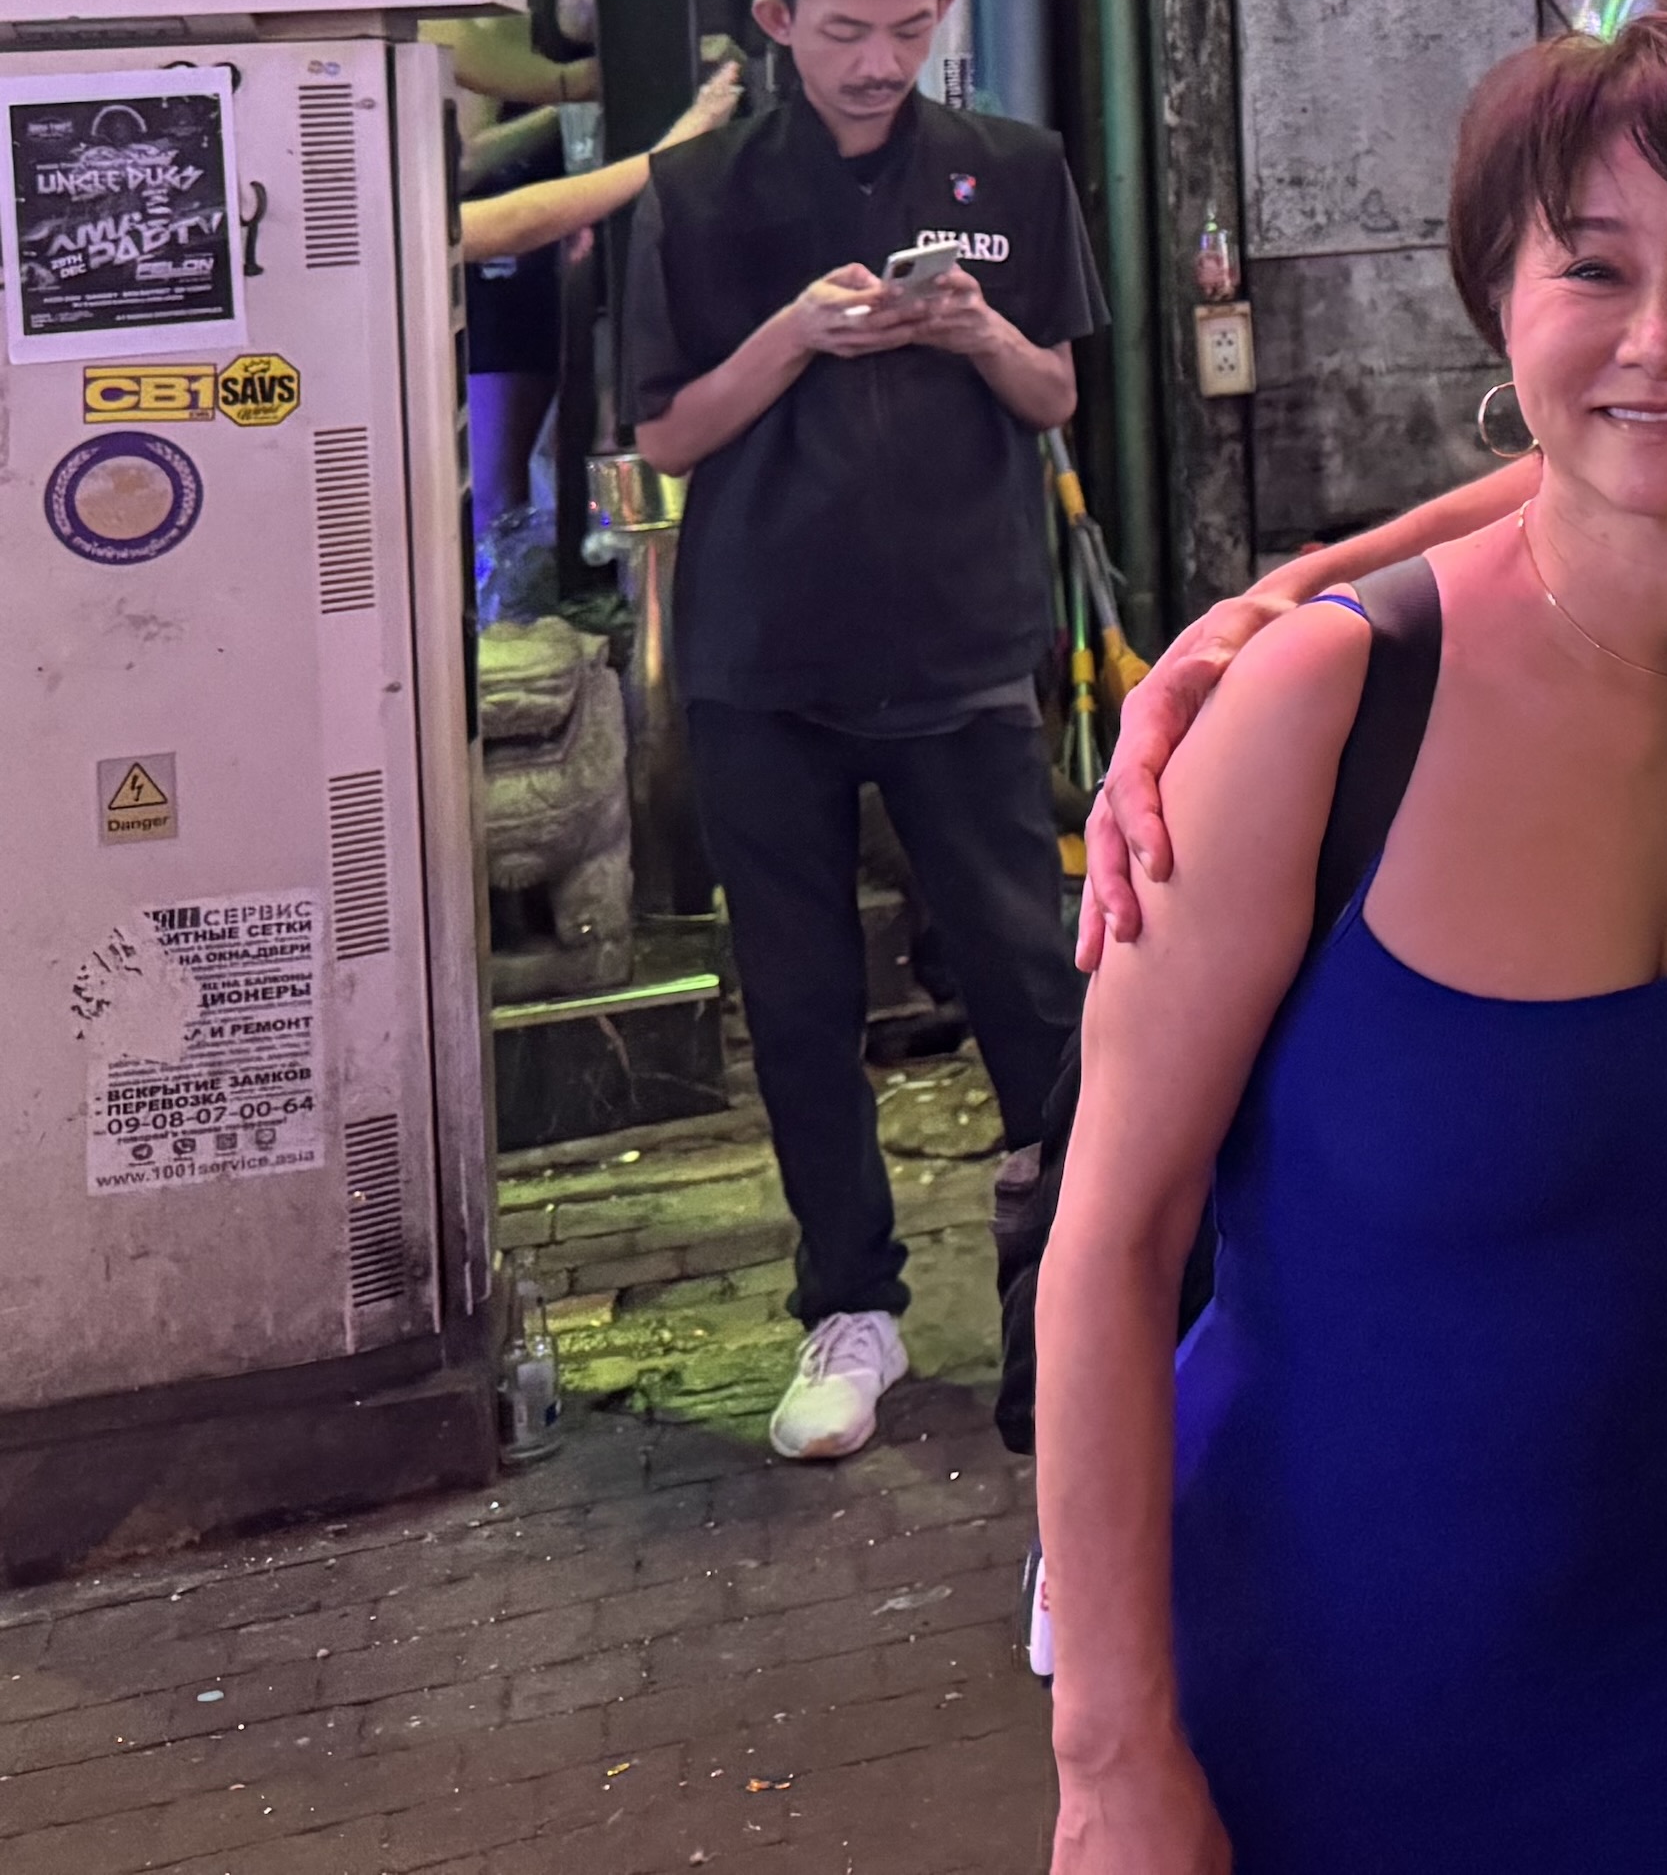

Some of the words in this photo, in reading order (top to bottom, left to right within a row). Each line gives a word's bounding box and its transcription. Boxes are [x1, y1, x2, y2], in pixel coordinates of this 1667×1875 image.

[85, 377, 215, 412] CB1
[221, 375, 295, 407] SAVS
[107, 814, 169, 834] Danger
[202, 900, 313, 927] СЕРВИС
[160, 927, 240, 947] ИТНЫЕ
[246, 919, 313, 939] СЕТКИ
[179, 954, 201, 966] НА
[230, 1016, 313, 1037] РЕМОНТ
[107, 1077, 222, 1103] ВСКРЫТИЕ
[228, 1067, 312, 1089] ЗАМКОВ
[107, 1092, 227, 1117] ПЕРЕВОЗКА
